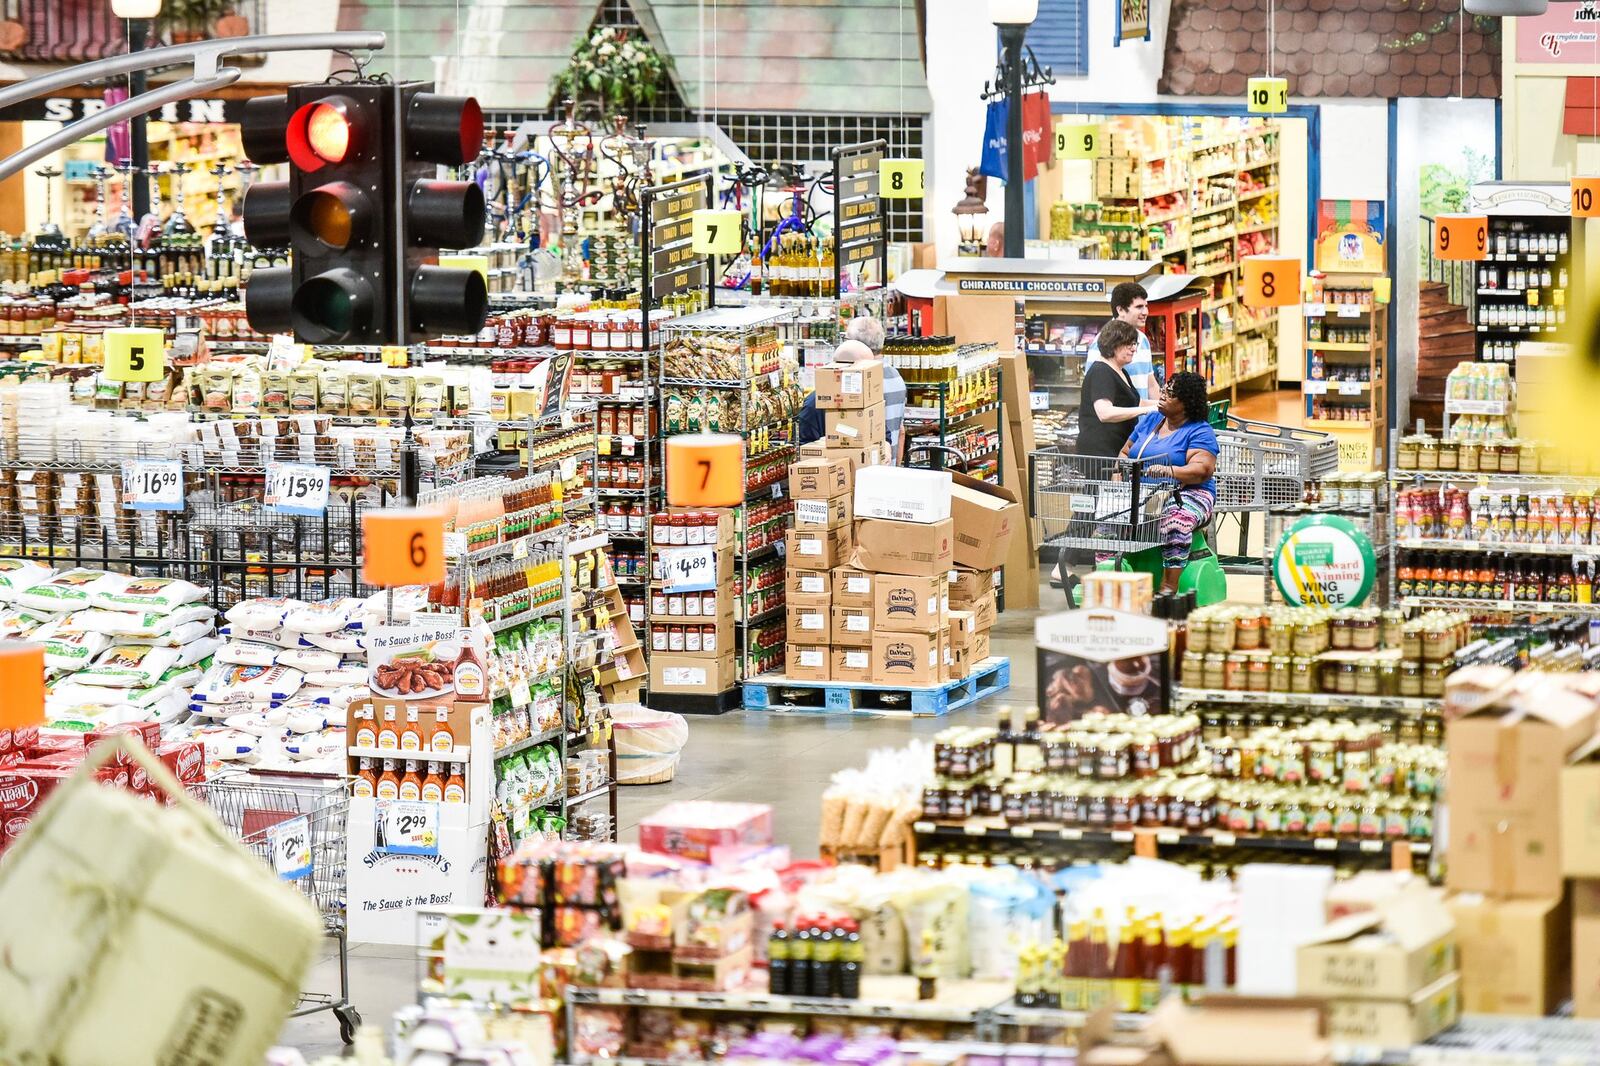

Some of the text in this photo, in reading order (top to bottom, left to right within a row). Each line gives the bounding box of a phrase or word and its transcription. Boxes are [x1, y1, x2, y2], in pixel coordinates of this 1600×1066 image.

[1253, 90, 1269, 105] 10
[1058, 134, 1065, 151] 9
[1083, 134, 1094, 151] 9
[891, 171, 903, 190] 8
[1573, 188, 1593, 211] 10
[707, 225, 718, 243] 7
[1440, 226, 1485, 252] 9 9
[961, 280, 1103, 292] GHIRARDELLI CHOCOLATE CO.
[1262, 271, 1275, 298] 8
[130, 347, 144, 371] 5
[698, 461, 711, 490] 7
[410, 532, 427, 569] 6
[1324, 561, 1359, 571] Award
[1311, 571, 1360, 582] Winning
[1301, 581, 1338, 592] WING
[1300, 593, 1345, 605] SAUCE
[374, 629, 456, 647] The Sauce is the Boss!
[363, 892, 452, 911] The Sauce is the Boss!
